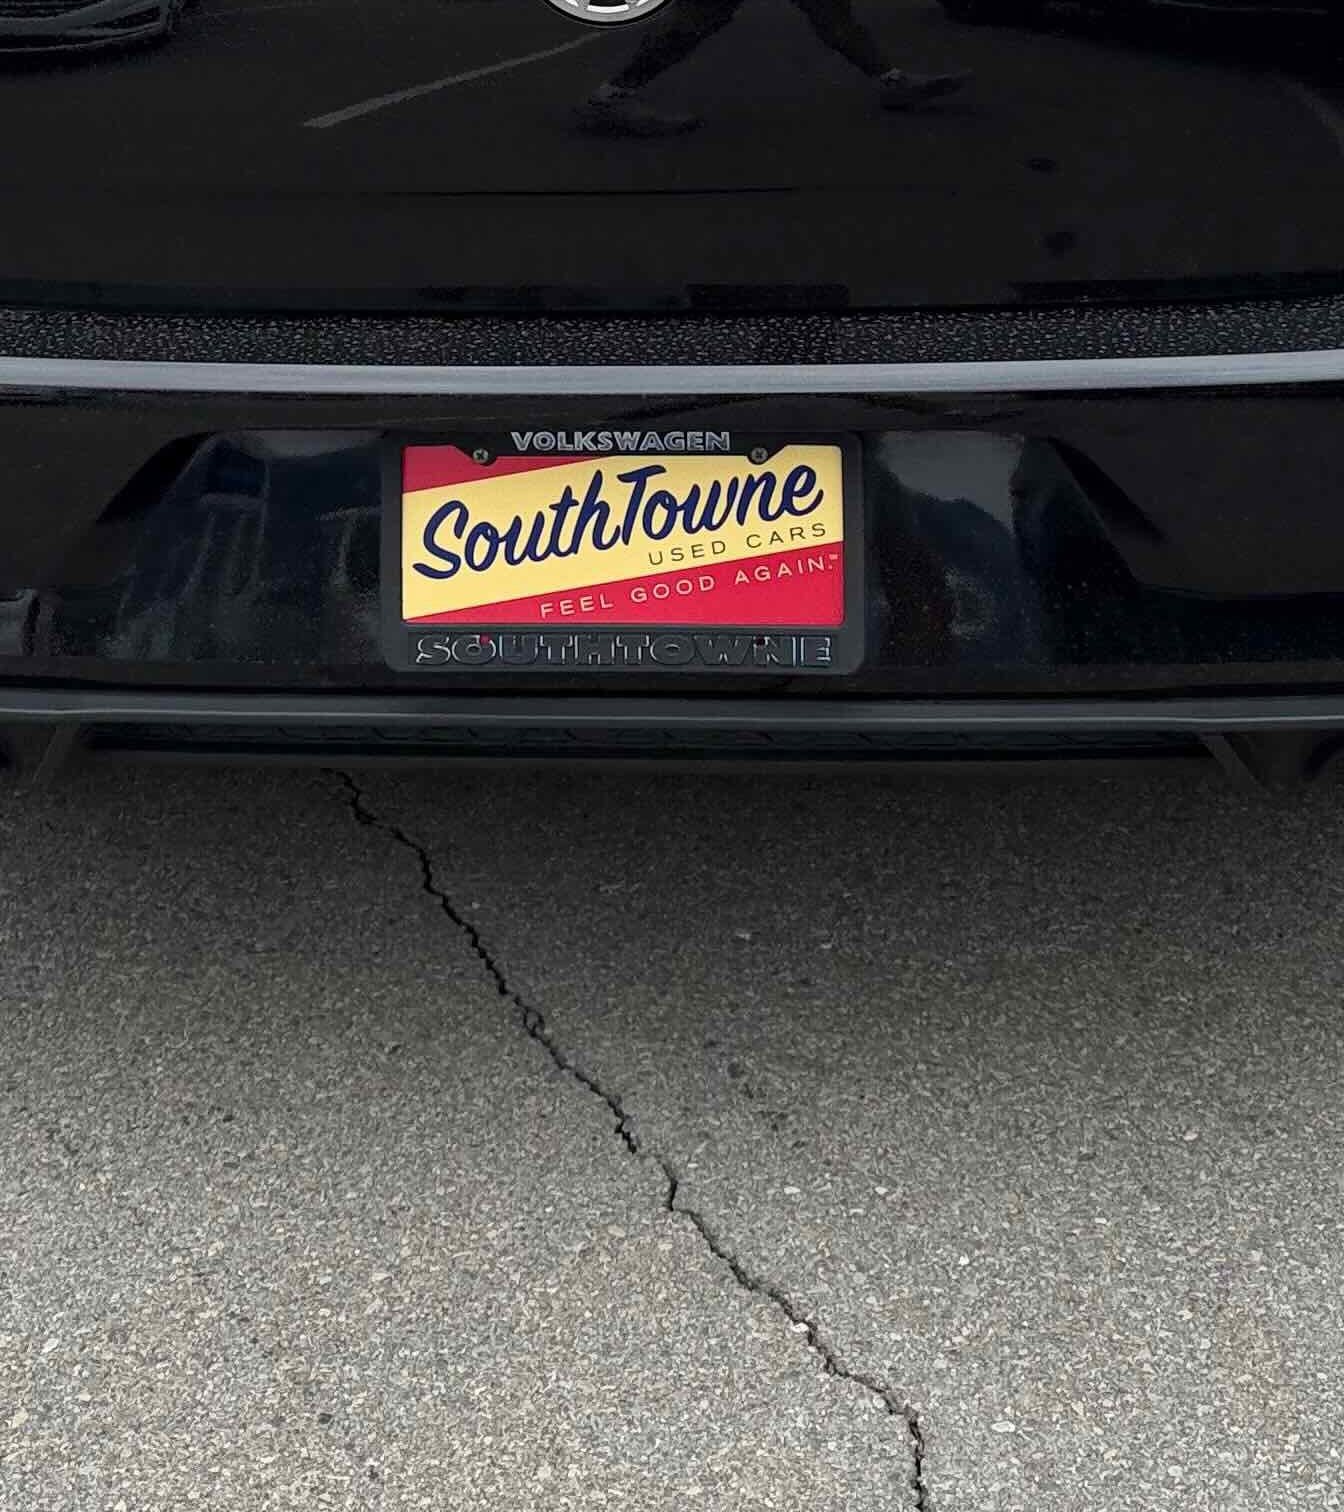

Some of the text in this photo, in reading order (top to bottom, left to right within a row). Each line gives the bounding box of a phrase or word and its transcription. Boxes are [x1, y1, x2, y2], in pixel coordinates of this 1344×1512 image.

[510, 431, 730, 452] VOLKSWAGEN
[648, 522, 827, 566] USED CARS
[539, 593, 614, 620] FEEL
[630, 575, 715, 603] GOOD
[416, 631, 832, 666] SOUTHTOWNE
